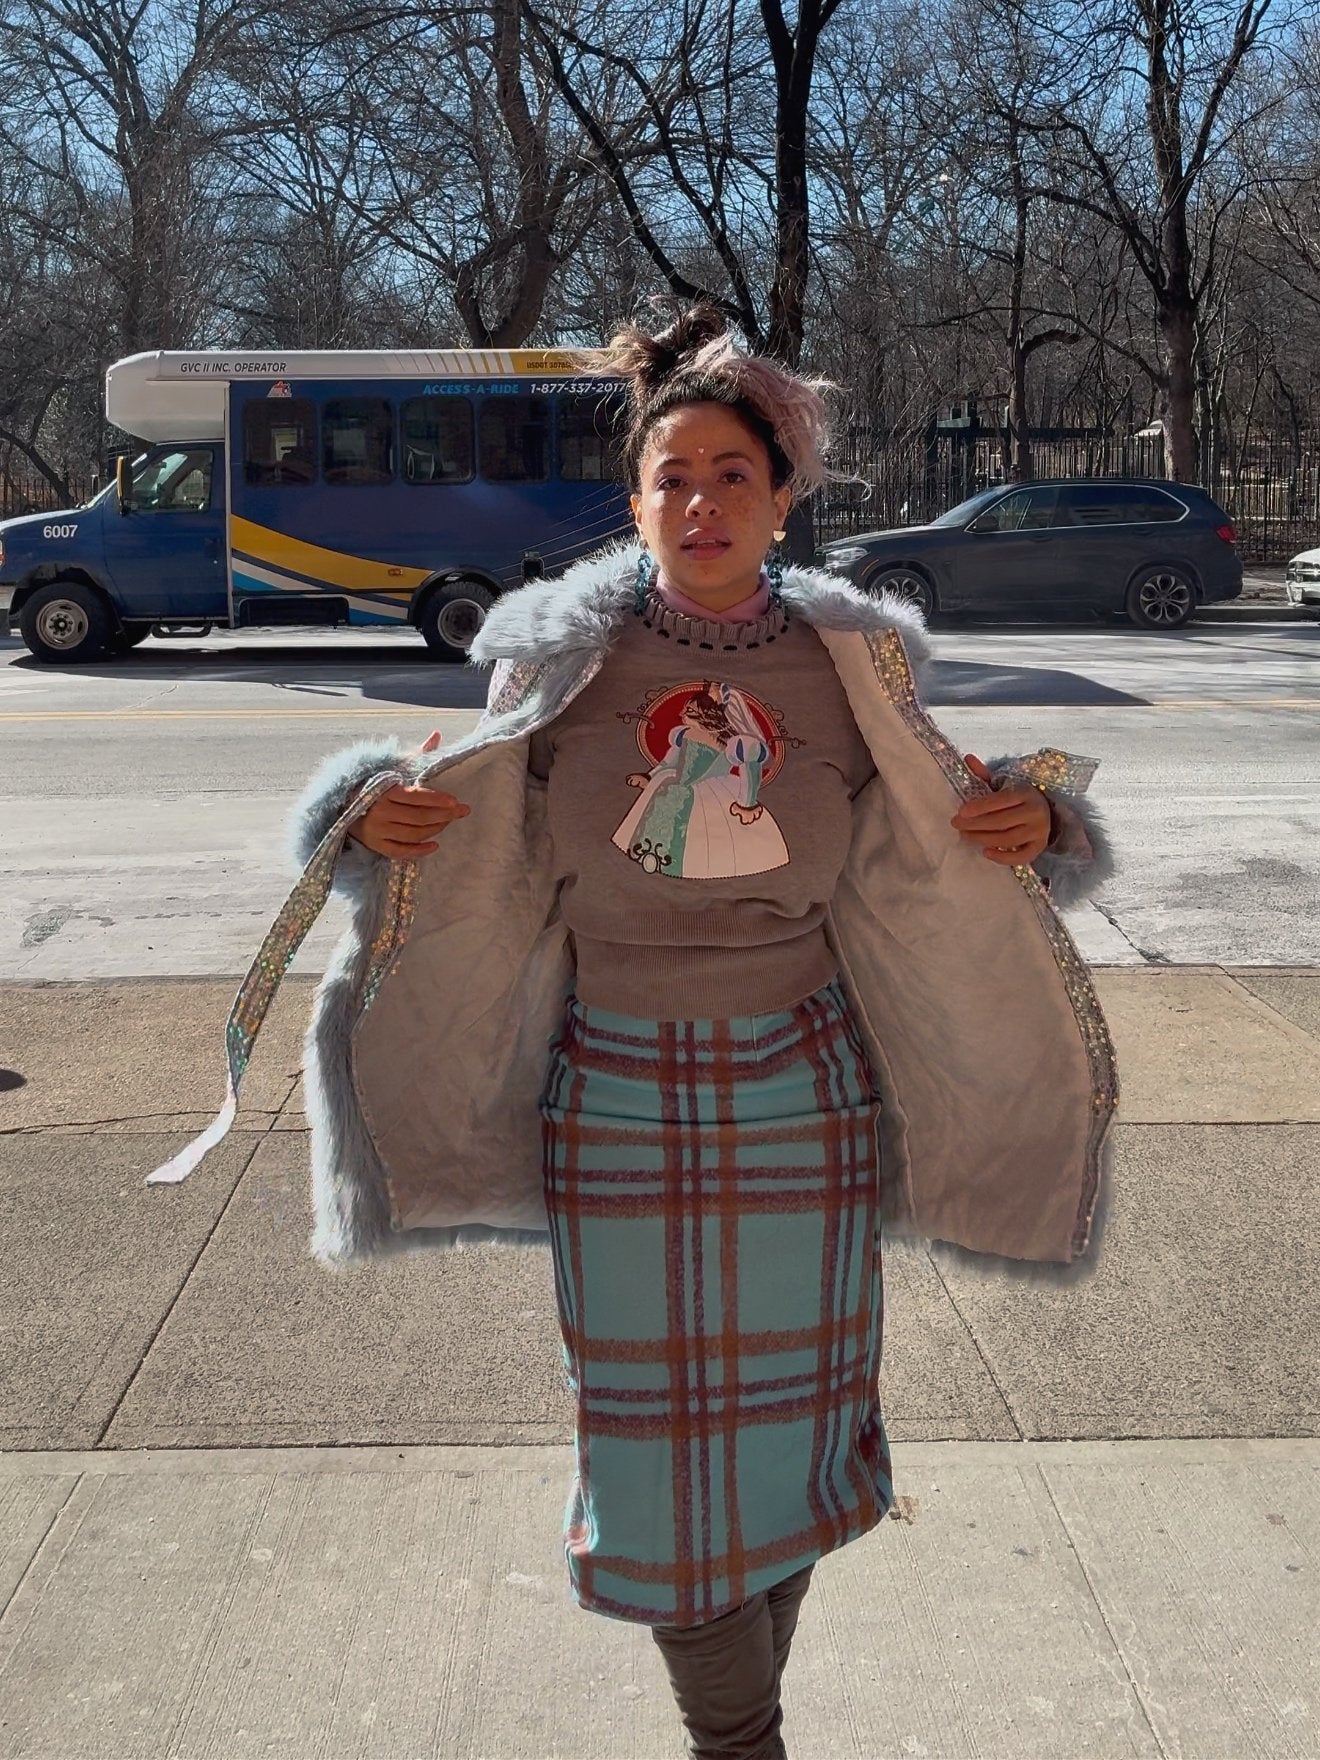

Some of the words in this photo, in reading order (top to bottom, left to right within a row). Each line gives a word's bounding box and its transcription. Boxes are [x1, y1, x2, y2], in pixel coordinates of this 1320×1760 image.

[180, 362, 201, 373] GVC
[212, 362, 231, 373] INC.
[234, 362, 287, 373] OPERATOR
[526, 361, 548, 369] USDOT
[423, 383, 519, 395] ACCESS-A-RIDE
[530, 383, 626, 394] 1-877-337-2017
[43, 524, 78, 538] 6007
